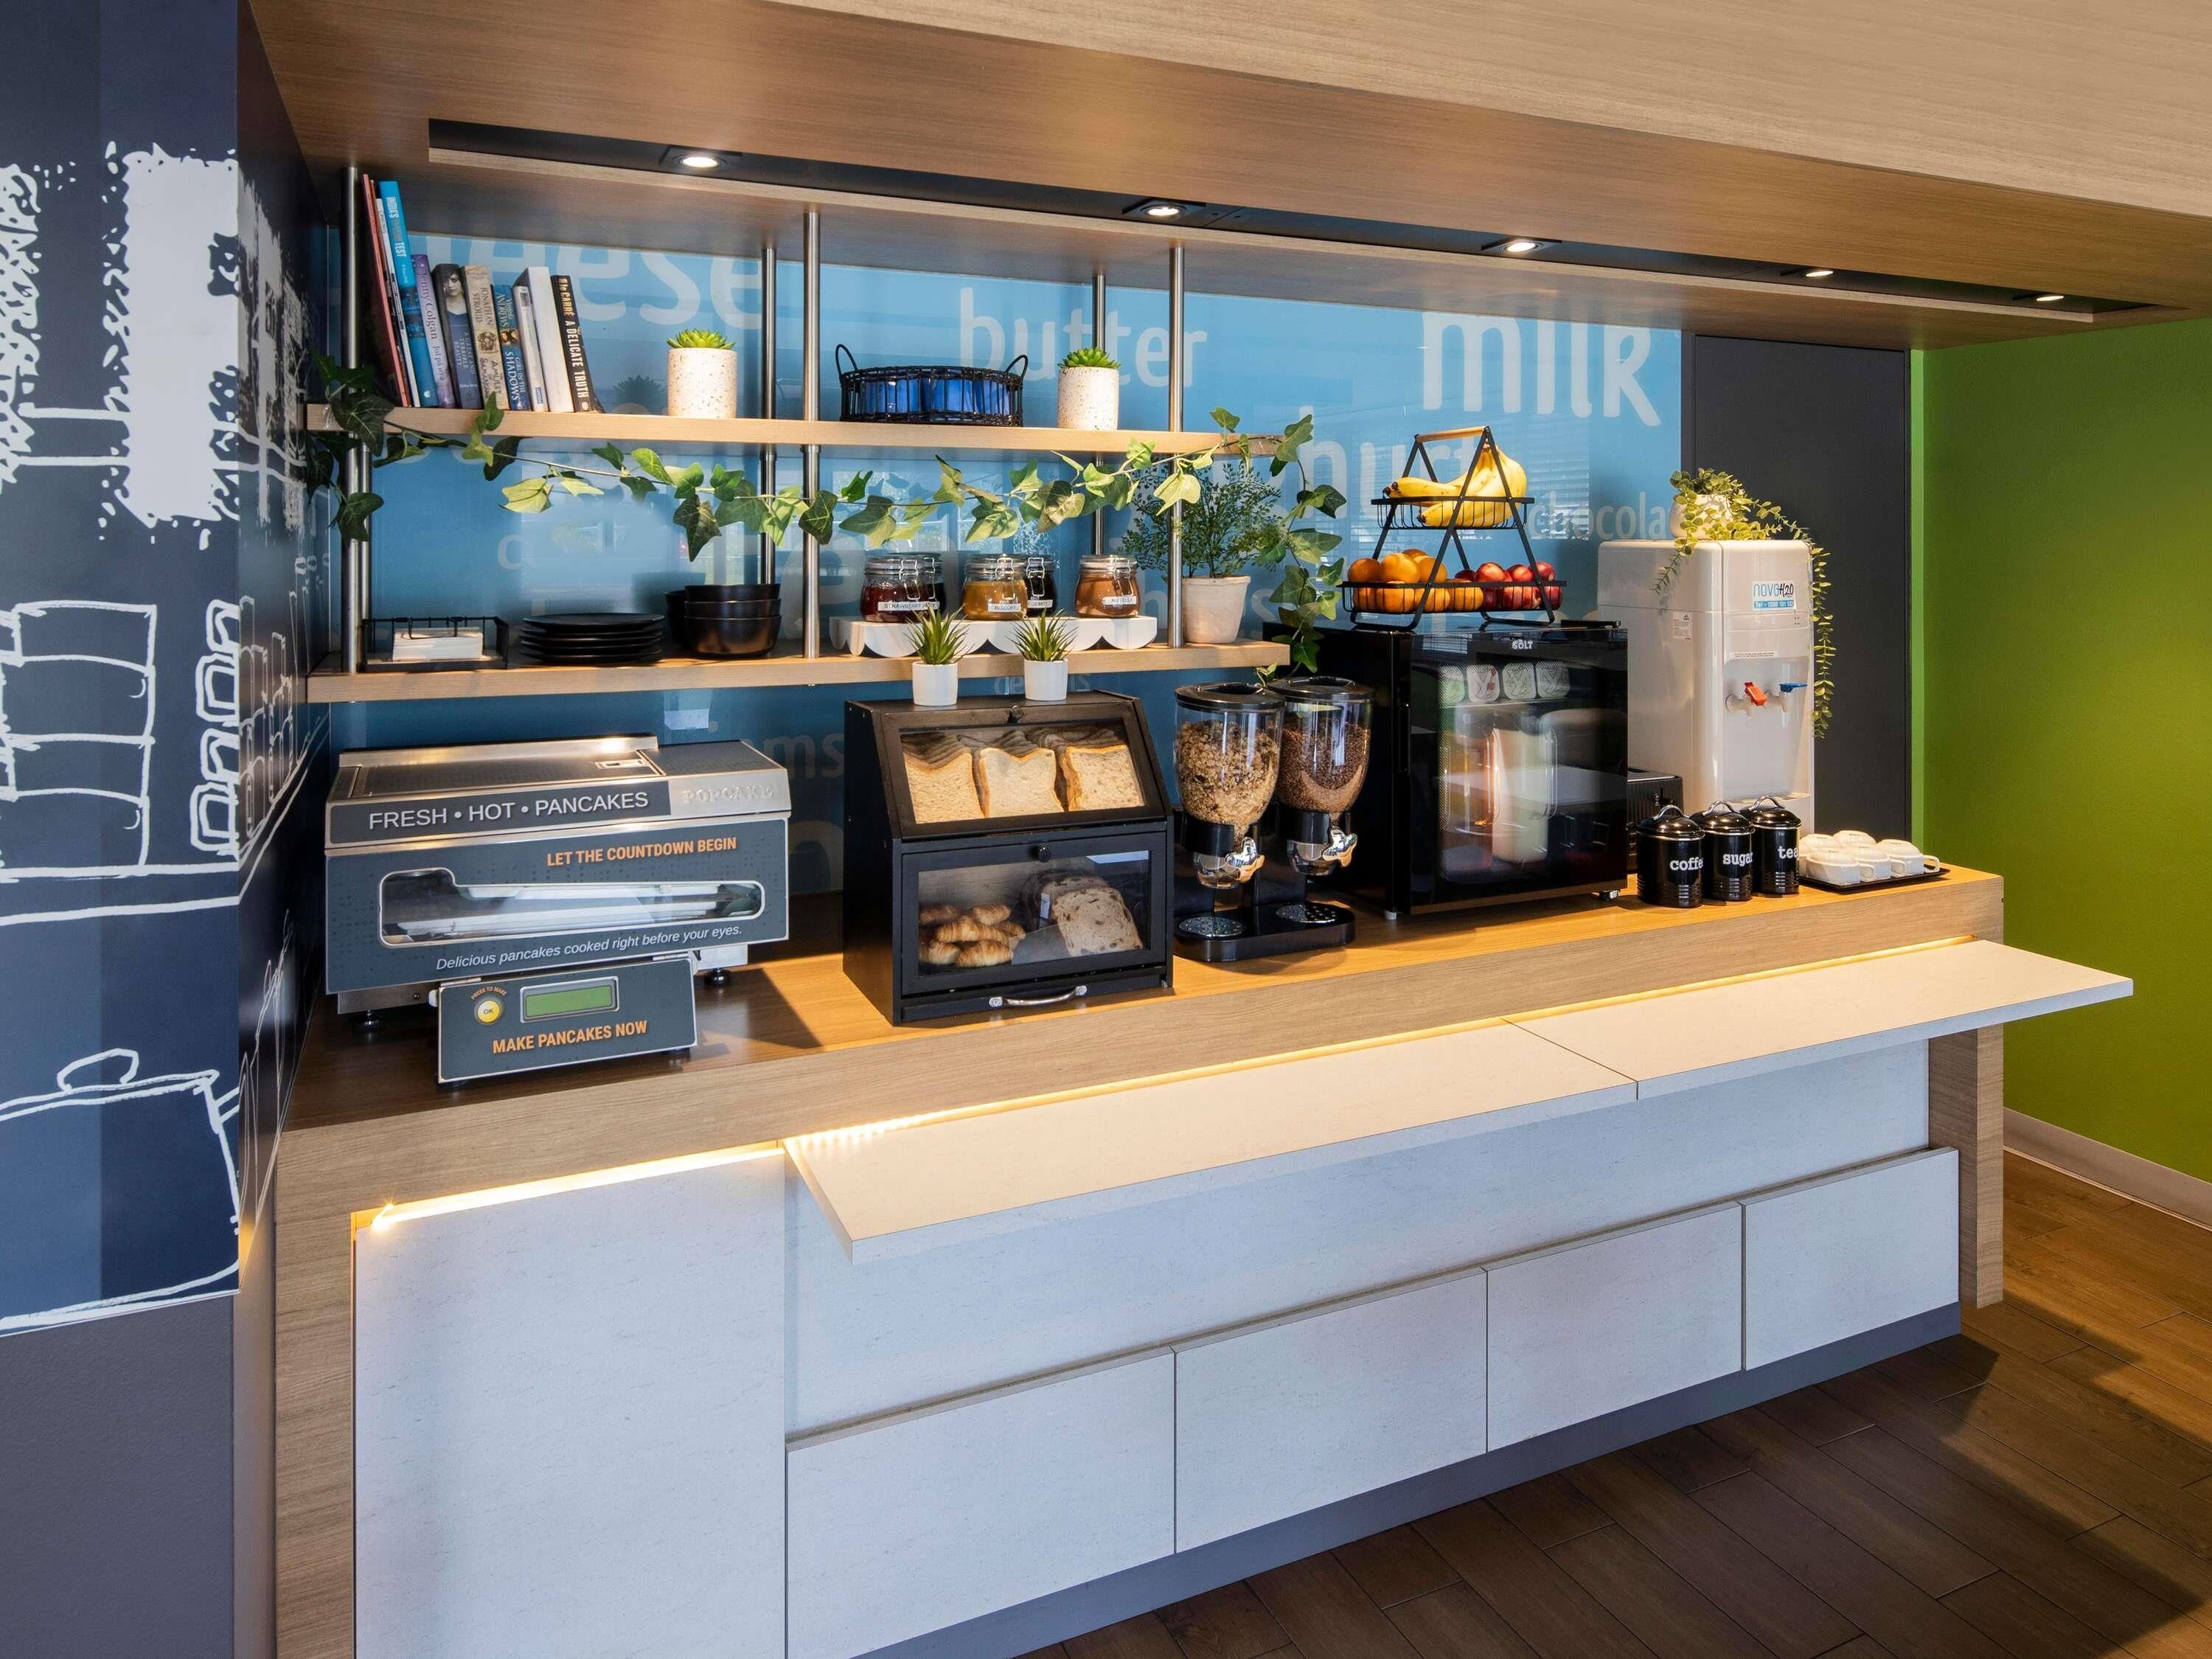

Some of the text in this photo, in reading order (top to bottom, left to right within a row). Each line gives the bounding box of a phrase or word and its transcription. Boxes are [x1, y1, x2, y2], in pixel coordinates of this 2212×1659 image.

[394, 242, 406, 258] TEST
[416, 271, 431, 301] Jenny
[422, 302, 439, 340] Colgan
[471, 292, 483, 323] STROUD
[480, 287, 493, 326] JONATHAN
[495, 291, 509, 327] ANDREWS
[961, 287, 1207, 389] butter
[504, 350, 521, 401] SHADOWS
[566, 327, 582, 366] DELICATE
[574, 370, 588, 398] TRUTH
[1422, 310, 1662, 428] milk
[1528, 490, 1670, 541] chocola
[369, 791, 650, 830] FRESH HOT PANCAKES
[683, 784, 774, 804] POPCAKE
[546, 836, 737, 867] LET THE COUNTDOWN BEGIN
[1669, 856, 1704, 871] coffe
[1722, 851, 1753, 866] sugar
[1777, 846, 1799, 859] tea
[436, 925, 742, 971] Delicious pancakes cooked right before your eyes.
[492, 1019, 648, 1055] MAKE PANCAKES NOW
